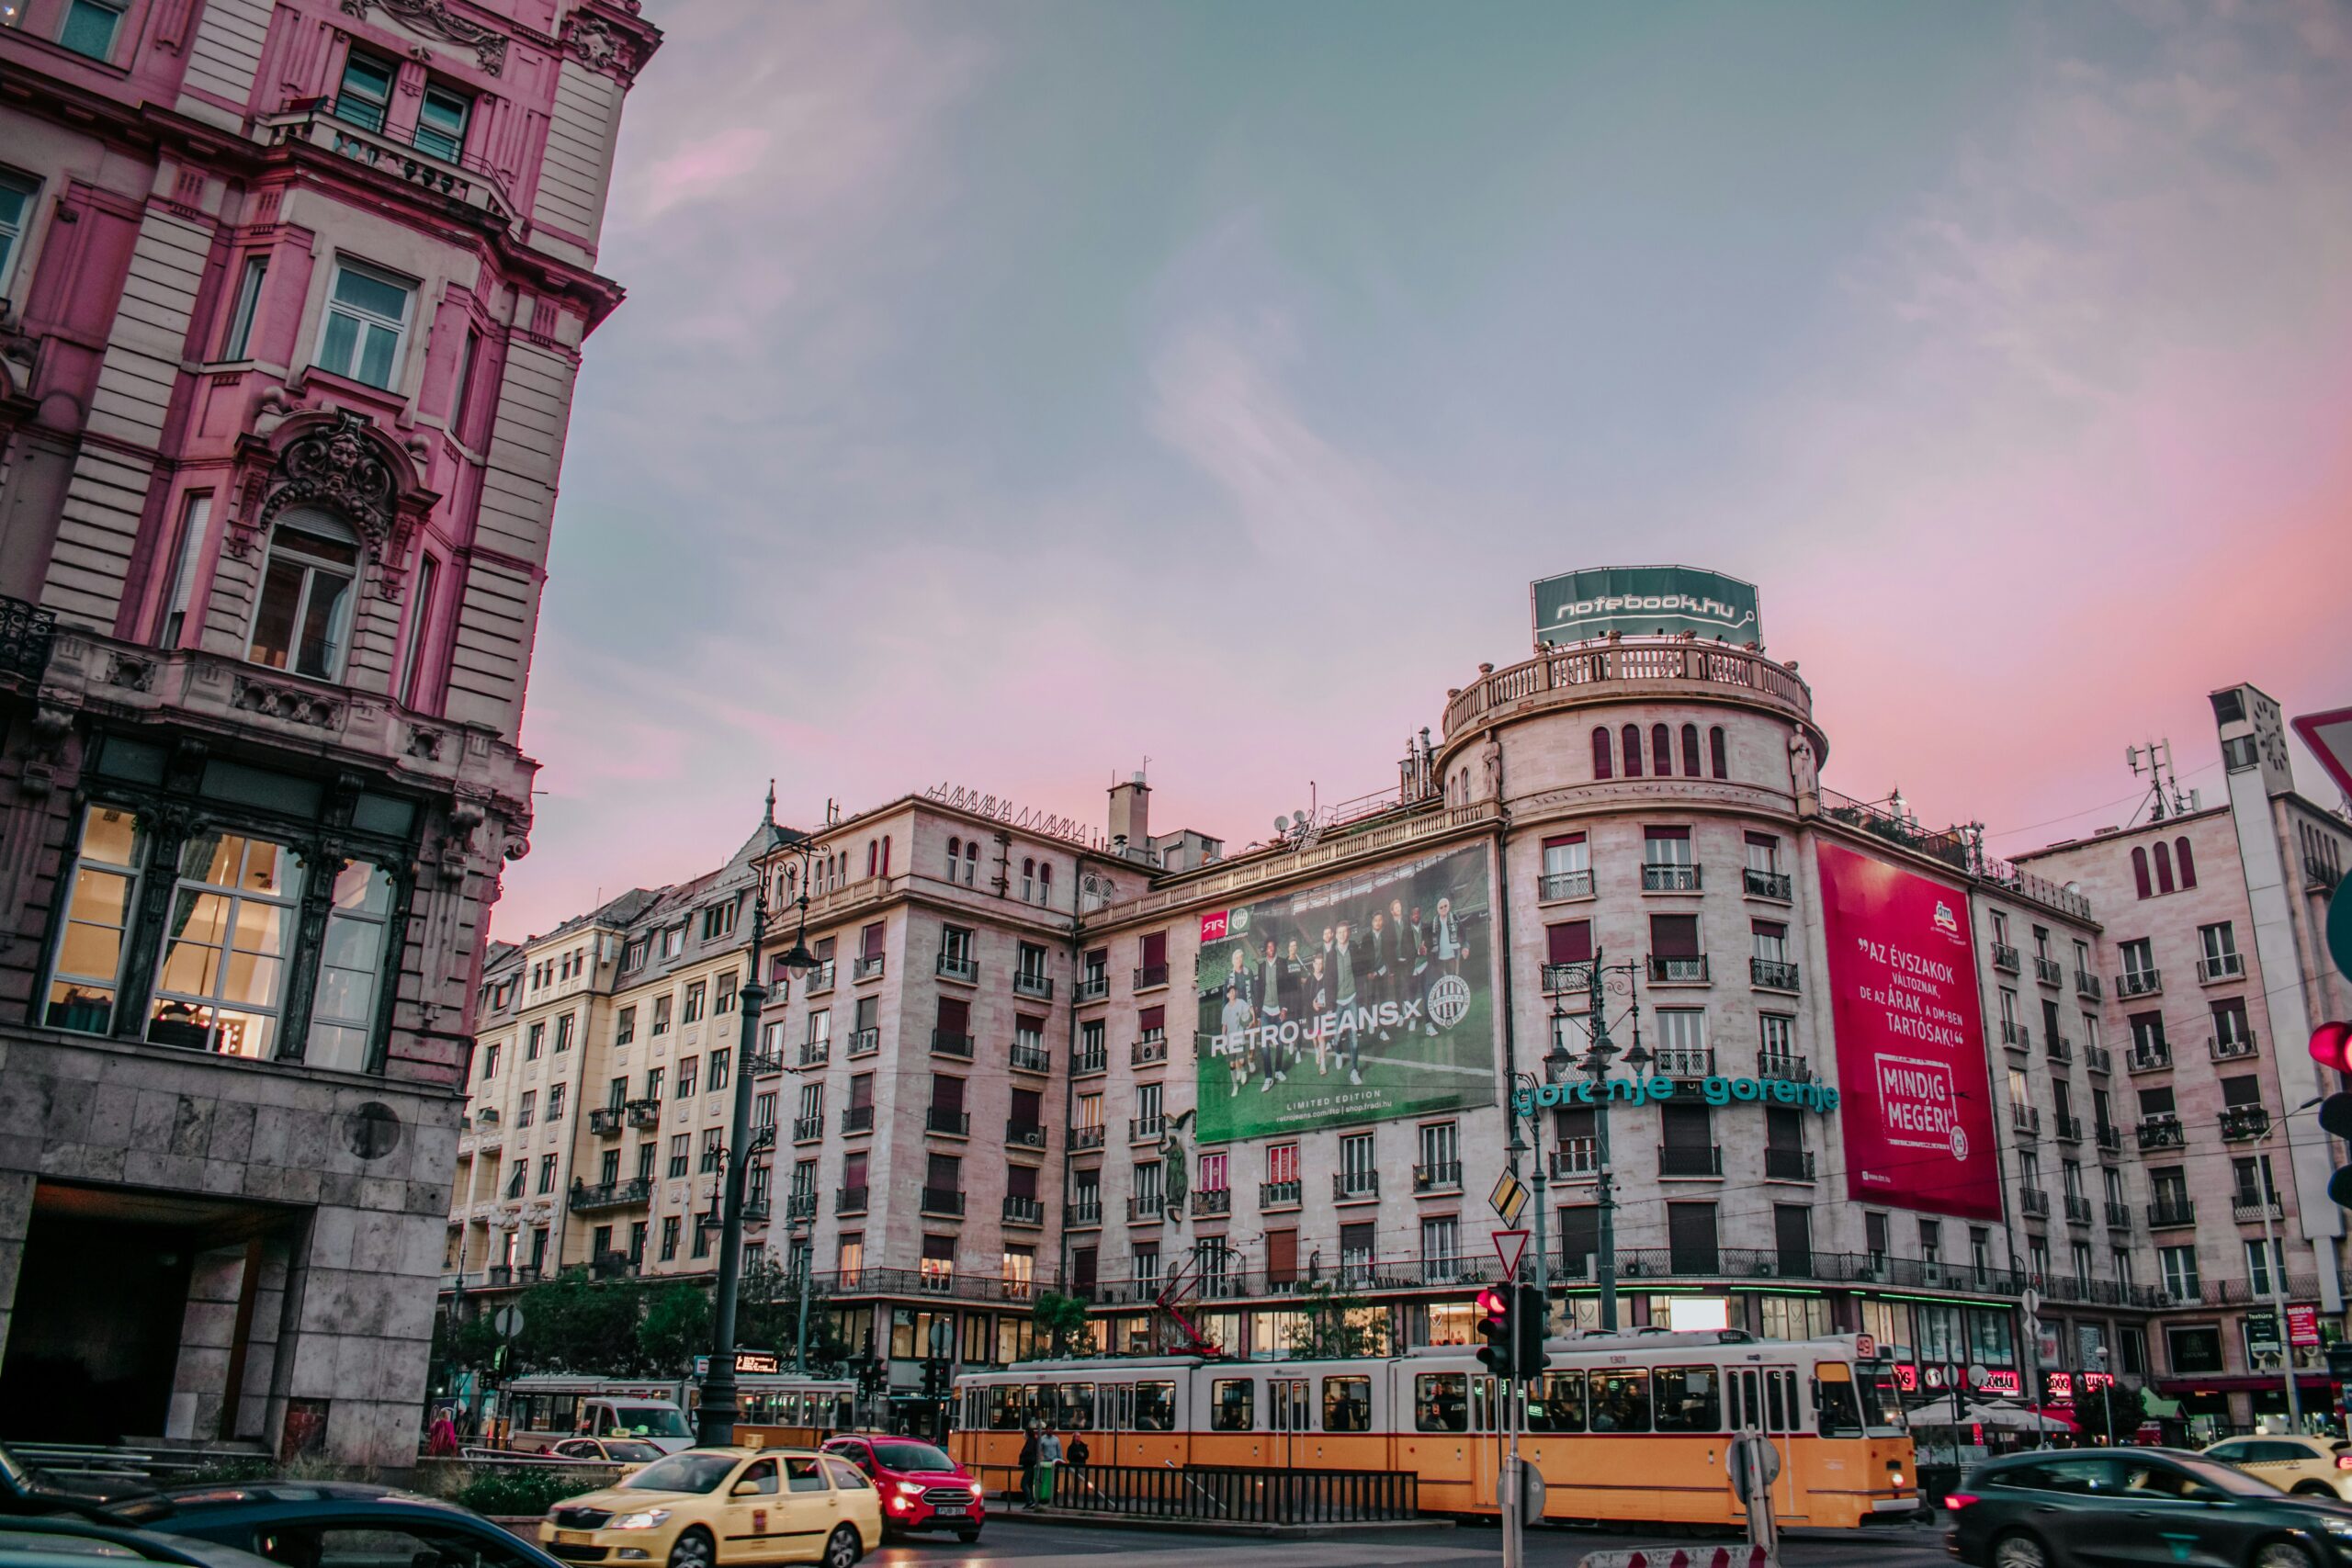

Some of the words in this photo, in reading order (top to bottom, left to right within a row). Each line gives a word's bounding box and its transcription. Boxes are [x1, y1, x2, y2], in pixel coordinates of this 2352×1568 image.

[1555, 593, 1735, 620] notebook.hu
[1890, 943, 1954, 985] ÉVSZAKOK
[1892, 972, 1941, 999] VÁLTOZNAK,
[1860, 986, 1872, 1001] DE
[1874, 990, 1886, 1005] AZ
[1887, 984, 1923, 1015] ÁRAK
[1926, 1005, 1932, 1018] A
[1933, 1006, 1963, 1026] DM-BEN
[1511, 1076, 1674, 1117] gorenje
[1703, 1075, 1839, 1113] gorenje
[1883, 1067, 1946, 1101] MINDIG
[1276, 1108, 1340, 1122] retrojeans.com/ftc
[1345, 1100, 1392, 1113] shop.fradi.hu
[1286, 1097, 1330, 1111] LIMITED
[1335, 1089, 1381, 1103] EDITION
[2287, 1306, 2313, 1314] DIEGO
[1856, 1338, 1871, 1355] 49
